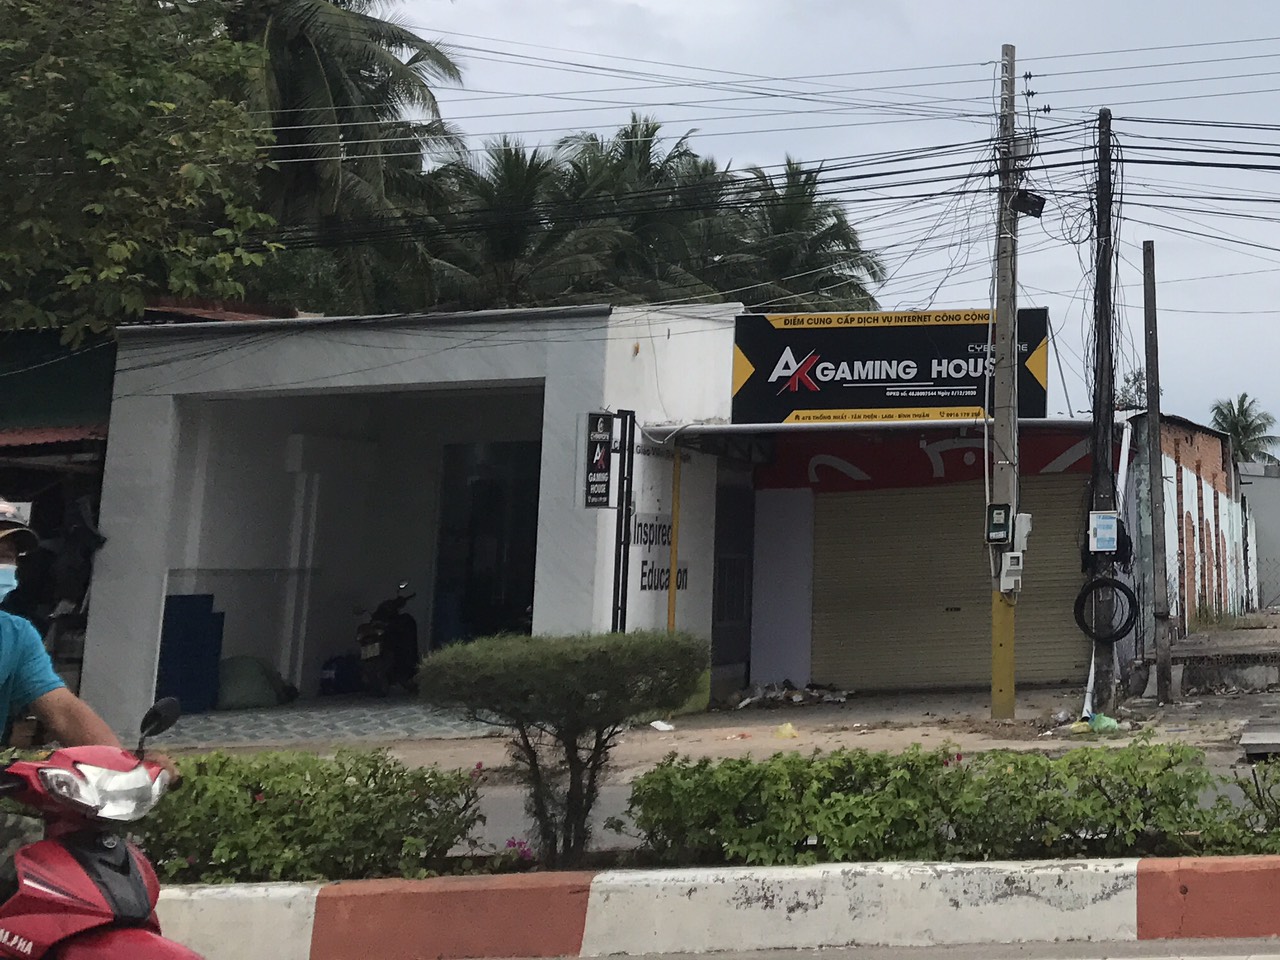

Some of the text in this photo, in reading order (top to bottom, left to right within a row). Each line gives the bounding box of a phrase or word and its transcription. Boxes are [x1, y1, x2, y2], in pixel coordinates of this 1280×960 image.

[784, 311, 990, 326] ĐIỂM CUNG CẤP DỊCH VỤ INTERNET CÔNG CỘNG
[768, 346, 997, 395] AK GAMING HOUS
[640, 560, 688, 591] Educaon
